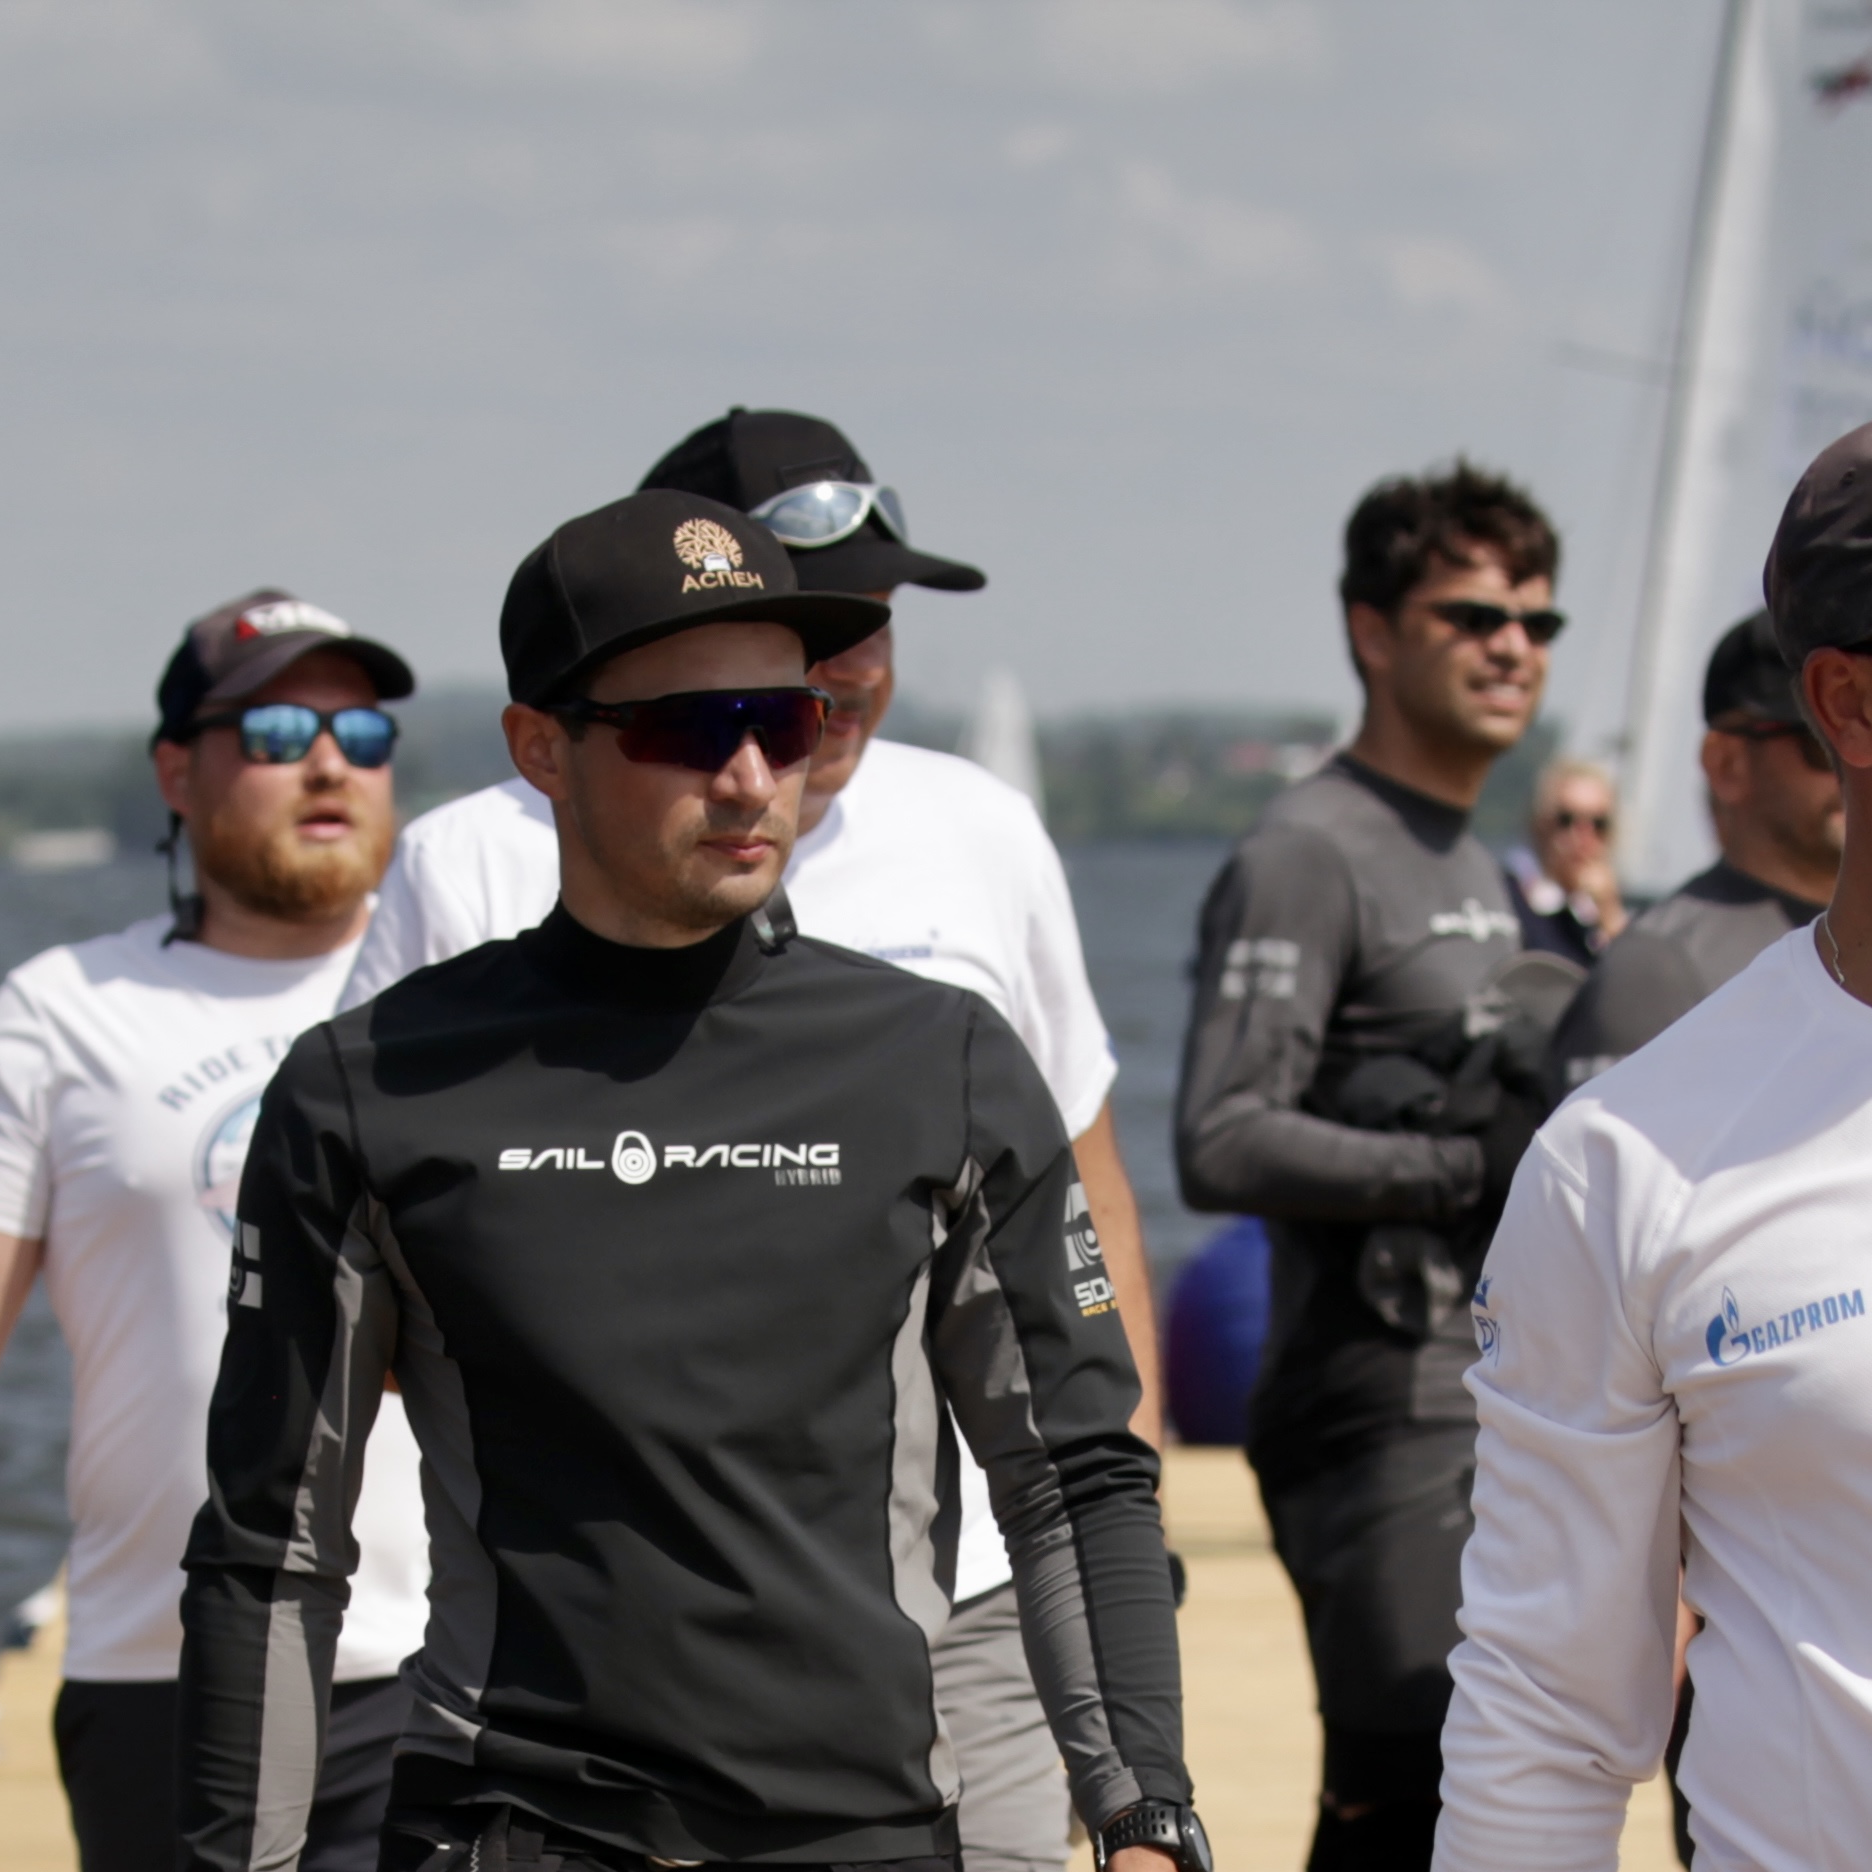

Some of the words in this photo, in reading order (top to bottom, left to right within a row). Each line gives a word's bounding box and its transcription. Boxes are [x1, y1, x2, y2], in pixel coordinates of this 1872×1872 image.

[681, 570, 765, 594] АСПЕН
[498, 1147, 606, 1170] SAIL
[664, 1143, 840, 1168] RACING
[774, 1167, 842, 1186] HYBRID
[1750, 1288, 1866, 1355] GAZPROM
